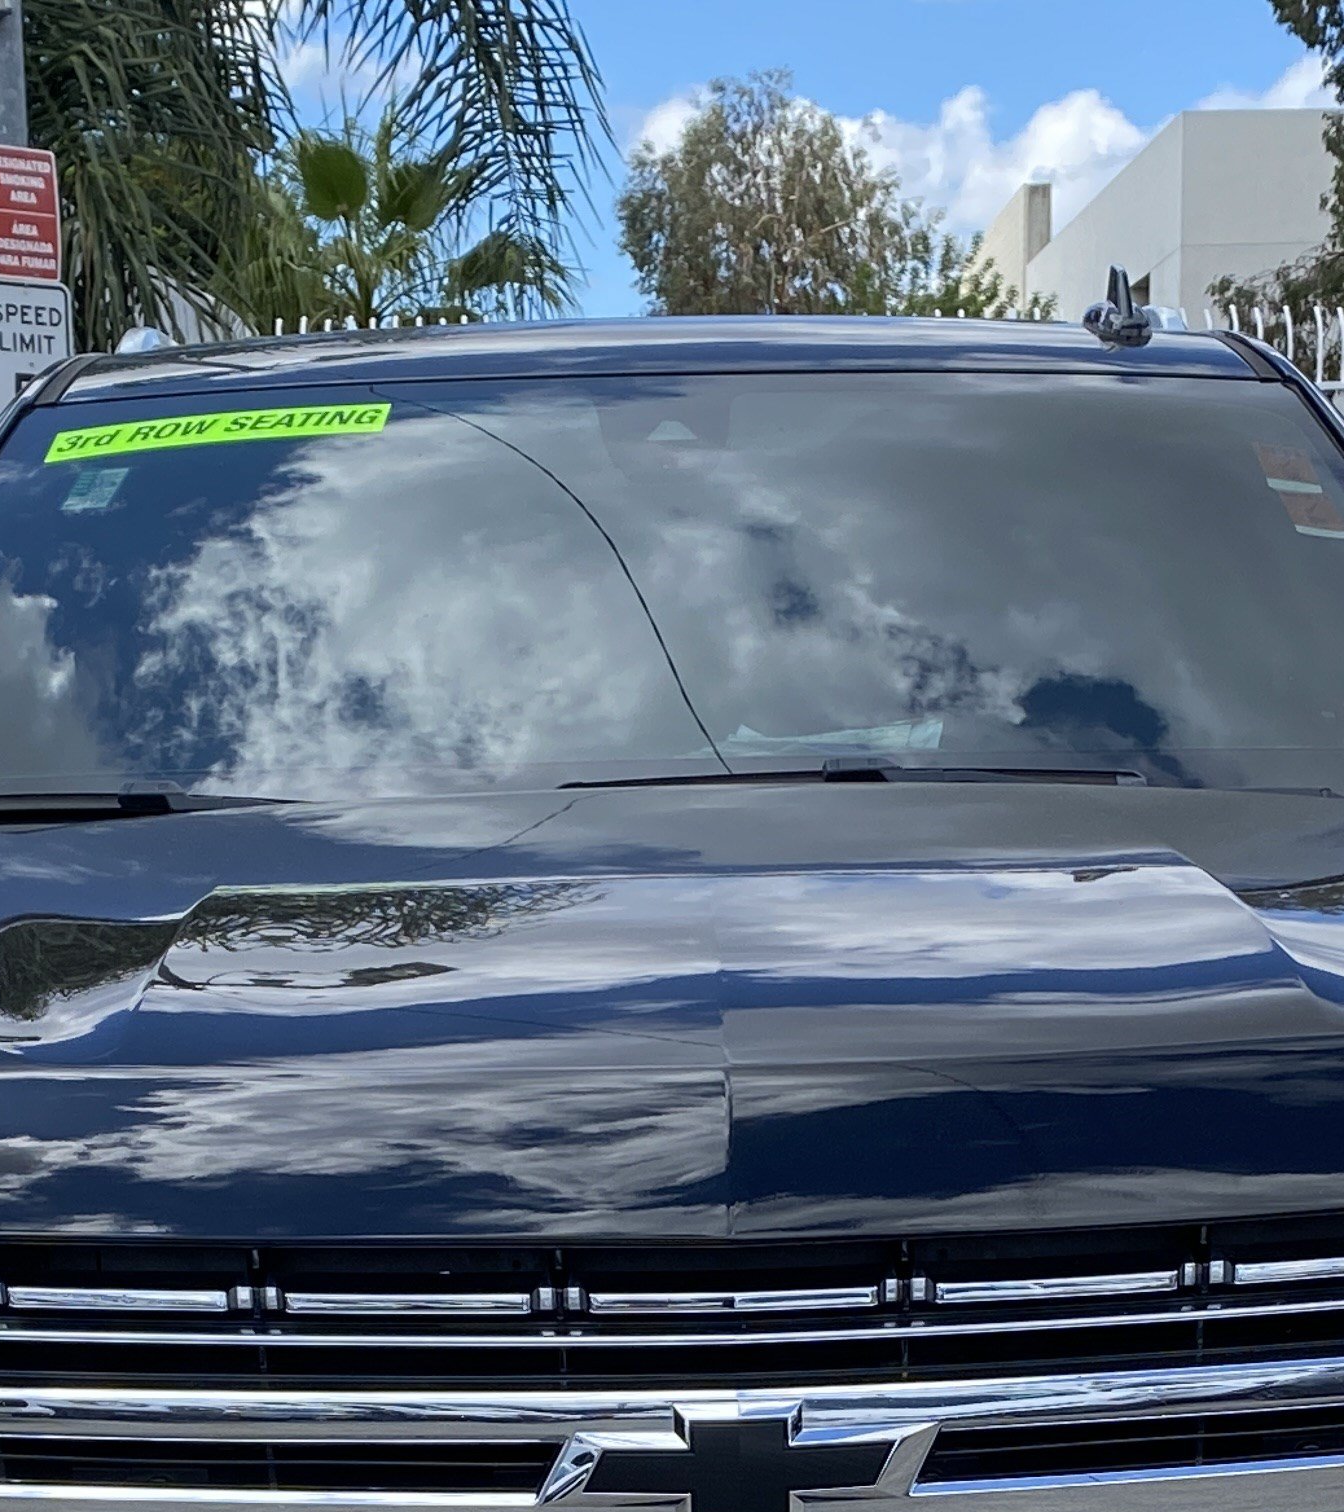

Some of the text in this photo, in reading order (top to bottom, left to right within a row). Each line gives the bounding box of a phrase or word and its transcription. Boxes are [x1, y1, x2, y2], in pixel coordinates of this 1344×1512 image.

[10, 189, 37, 204] AREA
[21, 257, 56, 270] FUMAR
[0, 331, 56, 355] LIMIT
[56, 408, 383, 453] 3rd ROW SEATING
